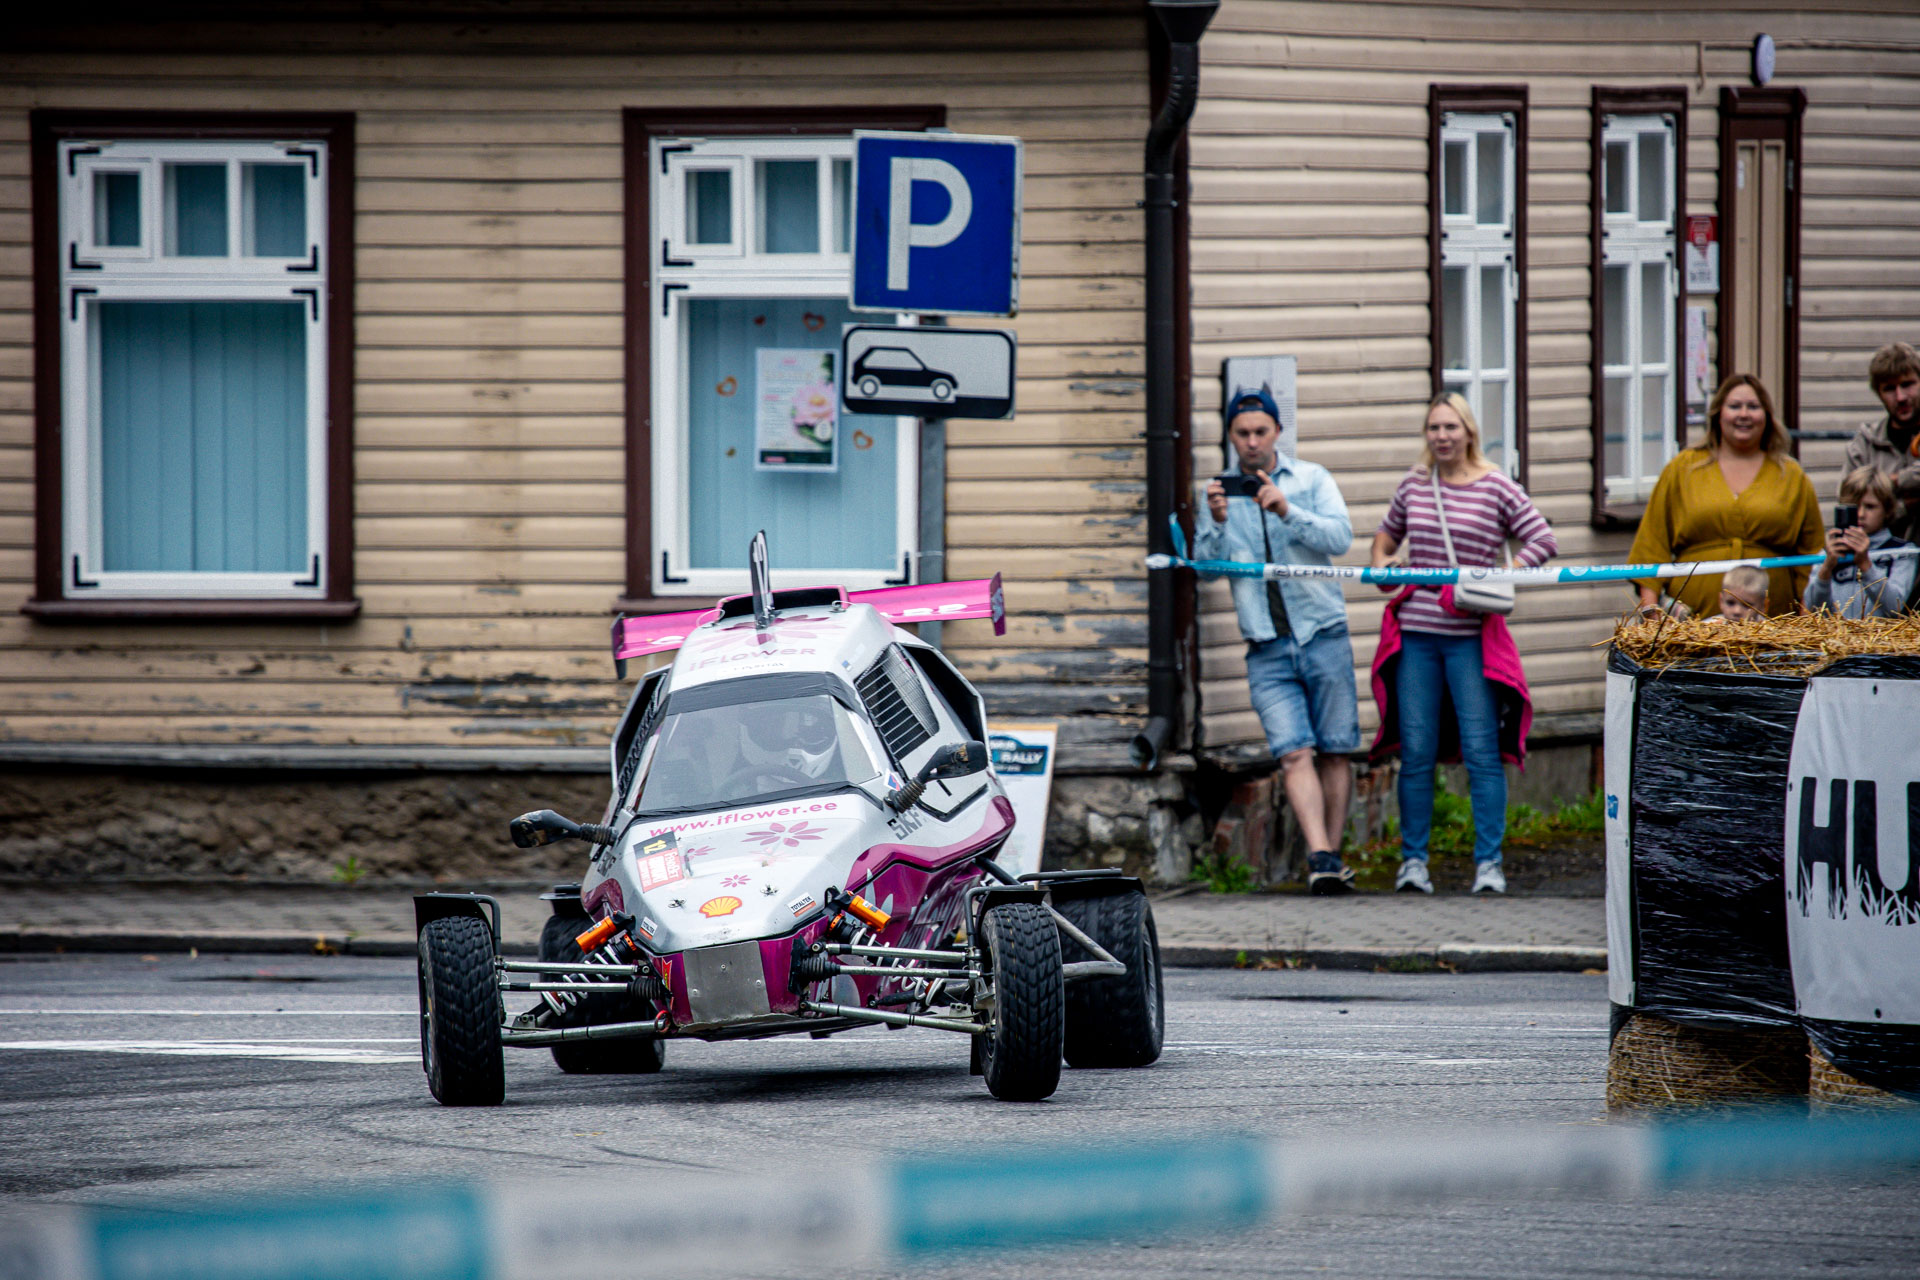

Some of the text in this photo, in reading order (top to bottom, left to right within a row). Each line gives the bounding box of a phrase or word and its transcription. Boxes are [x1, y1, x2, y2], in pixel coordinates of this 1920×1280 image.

[887, 156, 973, 291] P
[1293, 568, 1354, 578] CFMOTO
[1001, 751, 1044, 765] RALLY
[649, 802, 838, 837] www.iflower.ee
